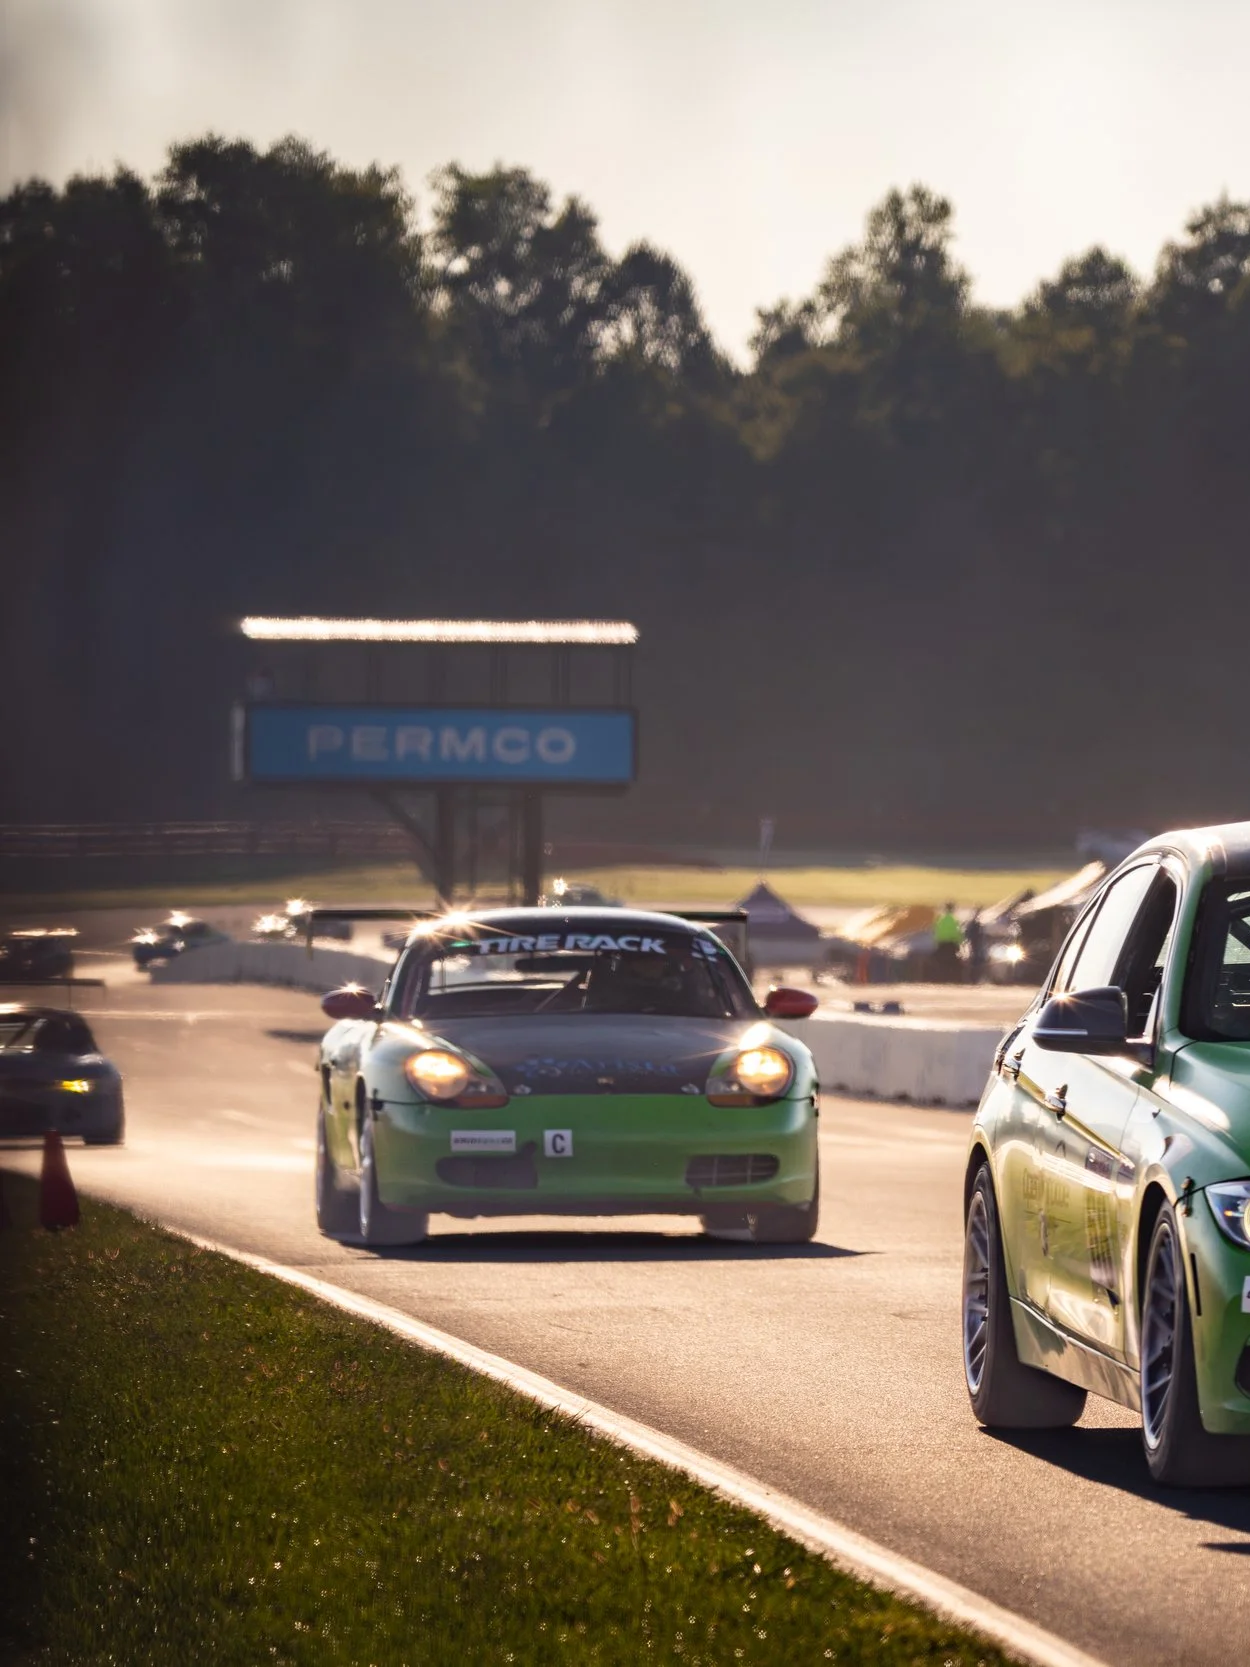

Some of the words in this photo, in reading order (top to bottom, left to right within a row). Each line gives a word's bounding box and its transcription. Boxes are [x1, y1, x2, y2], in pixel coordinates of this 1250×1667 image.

[307, 724, 577, 764] PERMCO
[479, 934, 561, 954] TIRE
[565, 934, 667, 954] RACK
[551, 1133, 565, 1154] C
